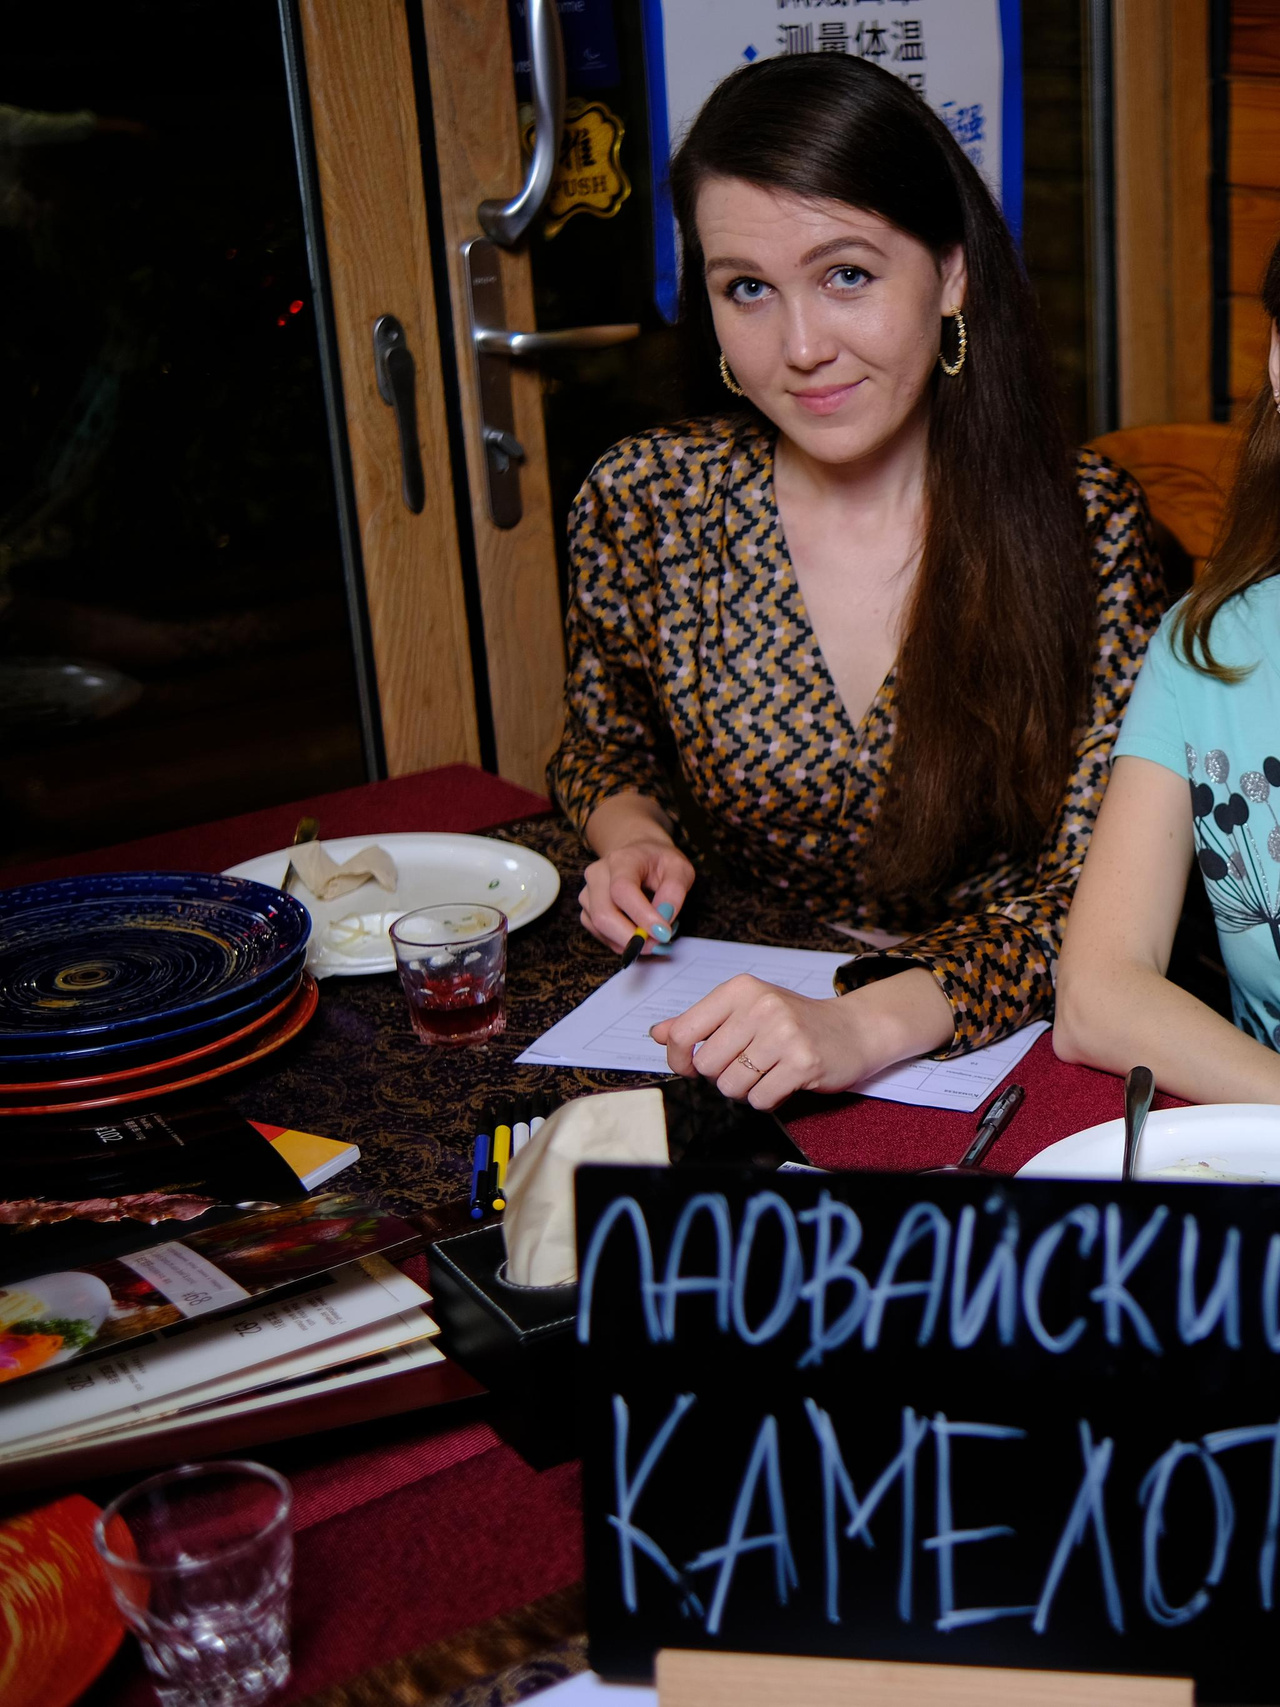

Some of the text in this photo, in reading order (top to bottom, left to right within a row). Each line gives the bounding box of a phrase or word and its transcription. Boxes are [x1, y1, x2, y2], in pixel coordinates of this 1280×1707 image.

[777, 19, 926, 63] 测量体温
[551, 175, 608, 200] PUSH
